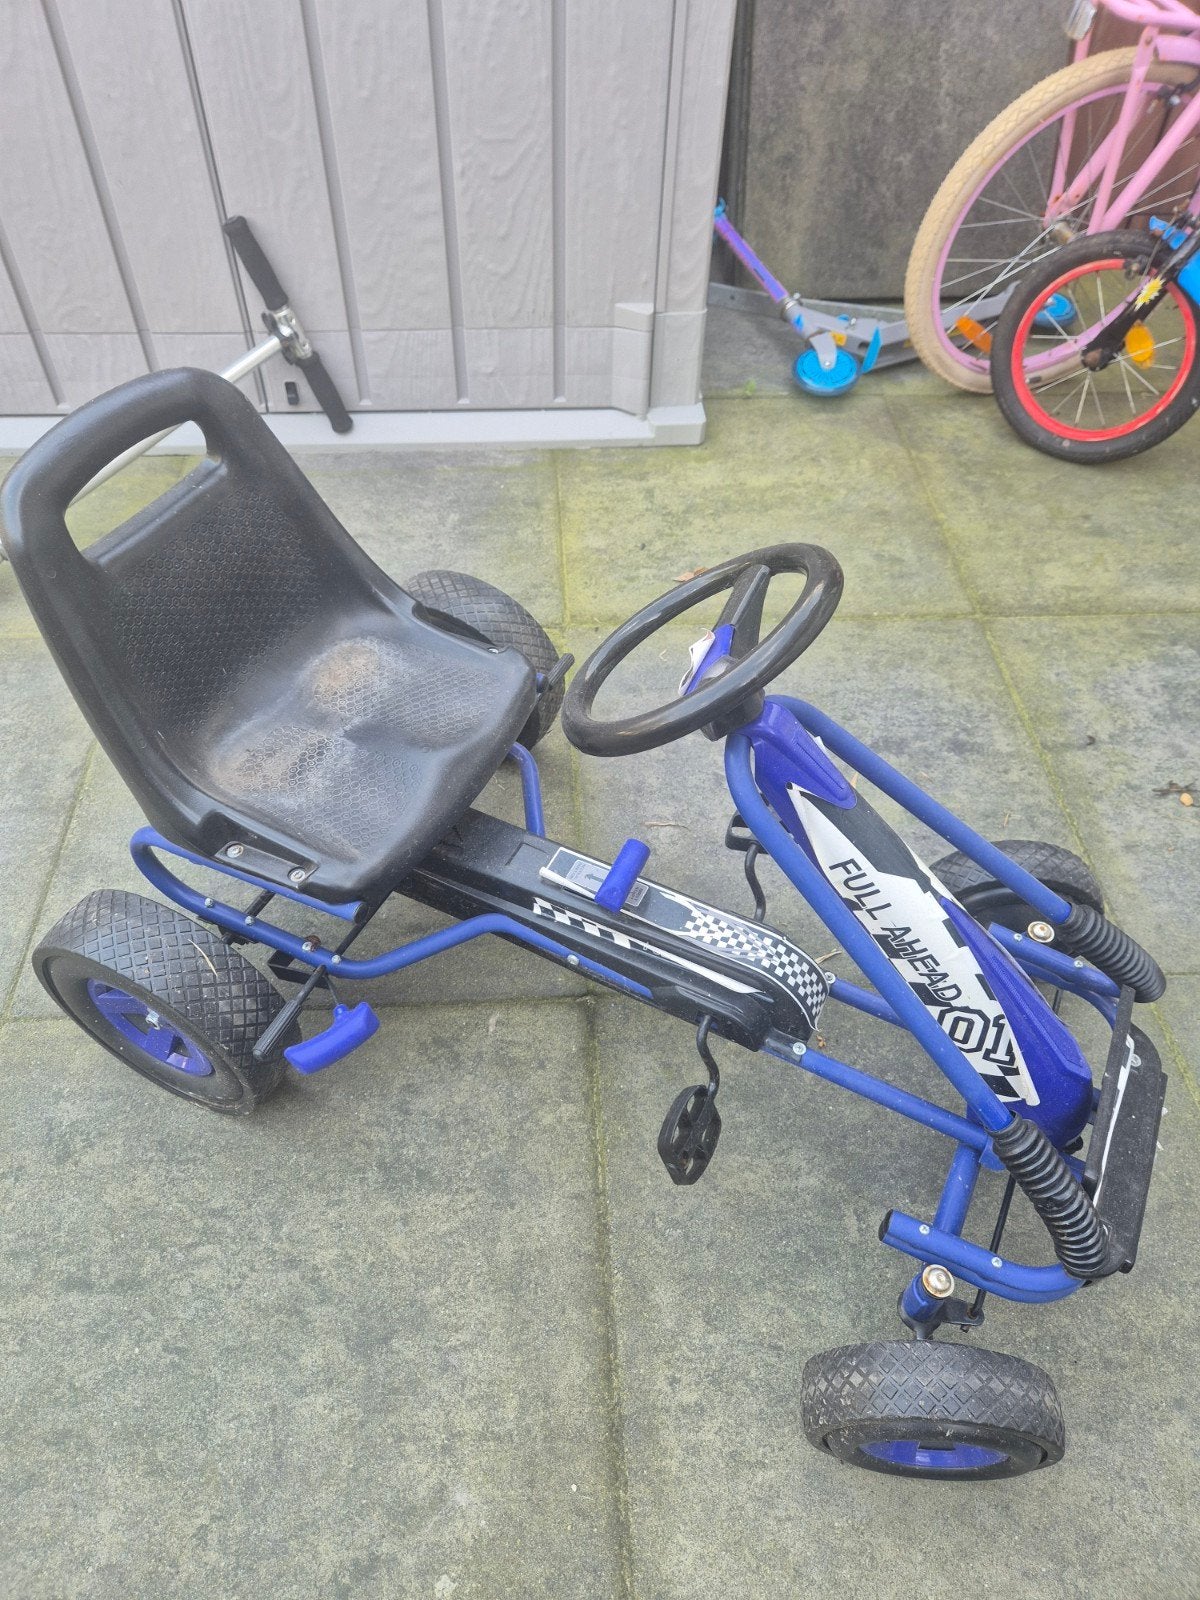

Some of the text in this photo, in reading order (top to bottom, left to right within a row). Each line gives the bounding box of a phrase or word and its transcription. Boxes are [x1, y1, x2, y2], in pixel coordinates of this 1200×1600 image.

[829, 858, 963, 1002] FULL AHEAD
[937, 1005, 1017, 1067] 01
